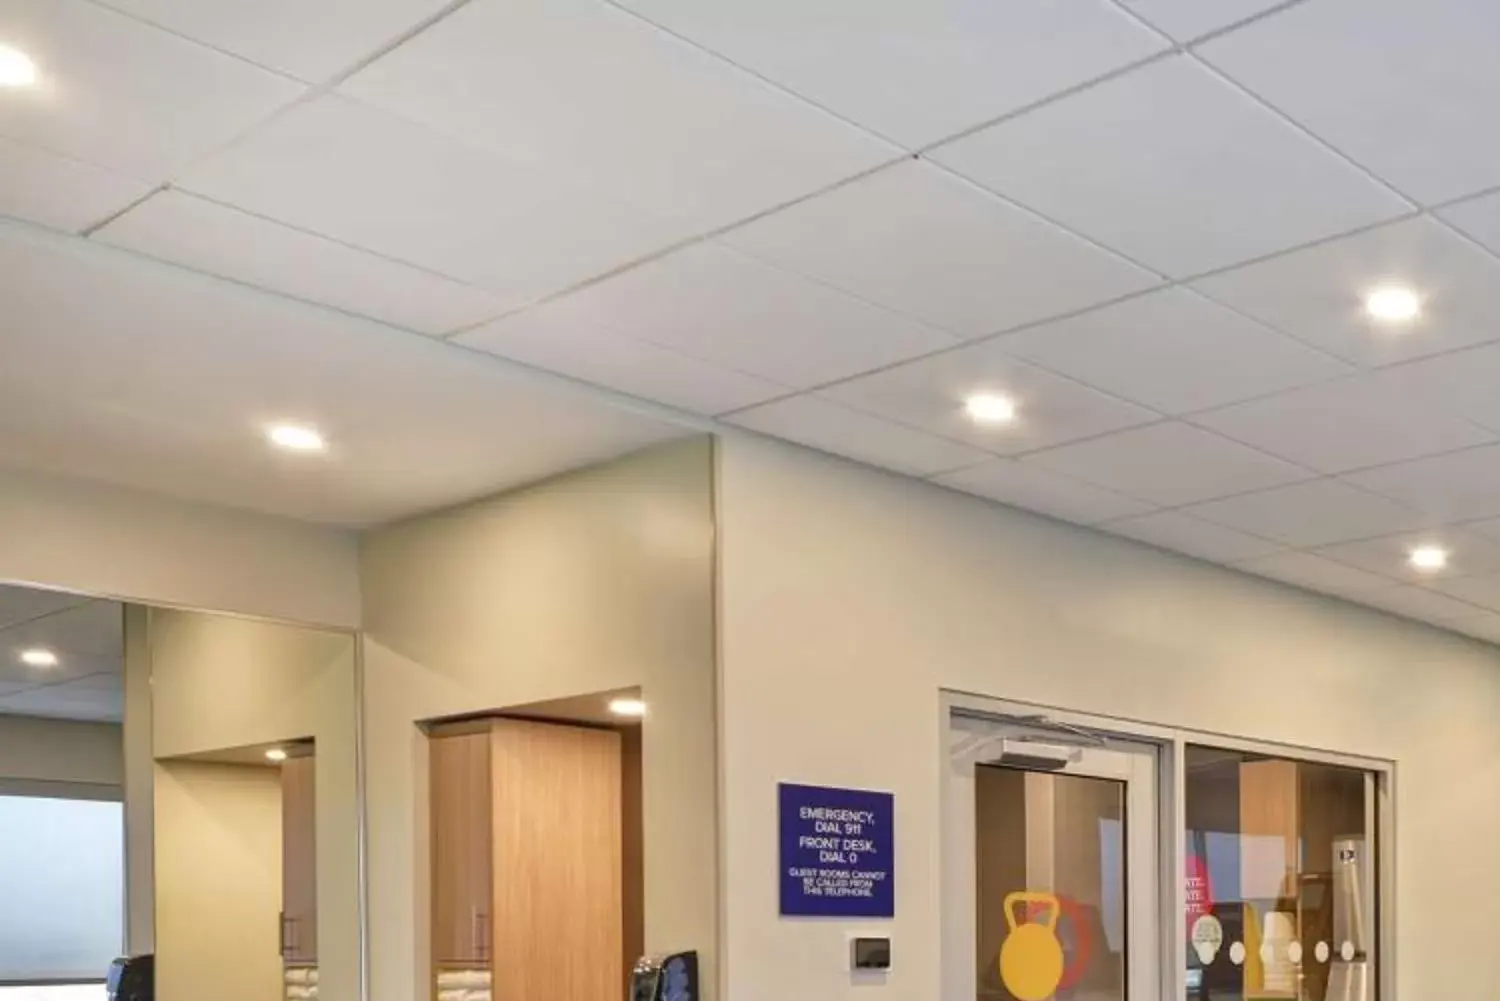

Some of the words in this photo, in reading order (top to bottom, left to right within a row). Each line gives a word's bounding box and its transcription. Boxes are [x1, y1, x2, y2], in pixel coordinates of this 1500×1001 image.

[800, 806, 875, 826] EMERGENCY,
[815, 821, 842, 834] DIAL
[845, 823, 861, 835] 911
[799, 836, 840, 850] FRONT
[819, 851, 847, 863] DIAL
